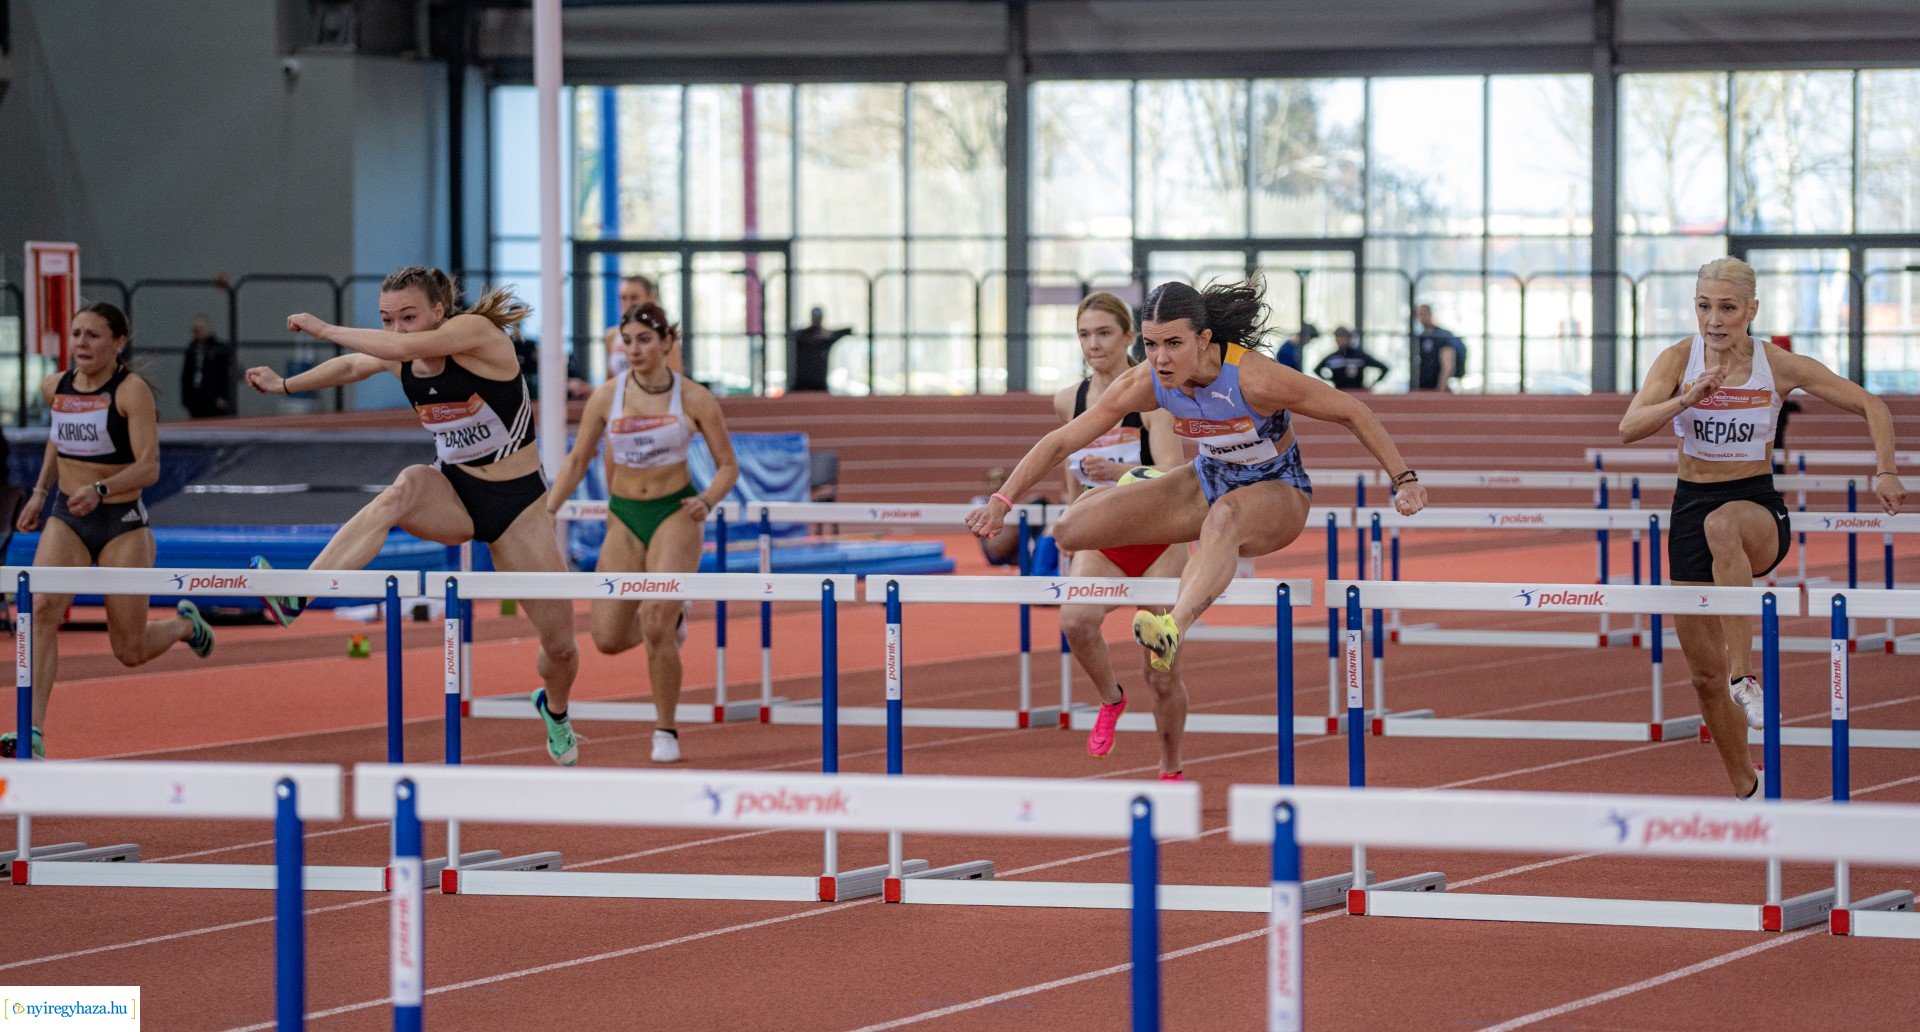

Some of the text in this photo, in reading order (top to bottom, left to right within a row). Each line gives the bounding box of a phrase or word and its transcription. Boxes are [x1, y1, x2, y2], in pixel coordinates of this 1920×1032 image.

[58, 422, 99, 442] KIRICSI
[1693, 416, 1755, 445] RÉPÁSI
[1500, 513, 1545, 525] polanik
[1835, 517, 1882, 530] polanik
[189, 575, 248, 591] polanik
[620, 578, 681, 595] polanik
[1067, 582, 1130, 600] polanik
[1537, 590, 1605, 608] polanik
[18, 631, 28, 668] polanik
[447, 637, 457, 675] polanik
[888, 642, 898, 680] polanik
[1348, 649, 1359, 688] polanik
[1833, 659, 1844, 699] polanik
[733, 786, 852, 821] polanik
[1641, 811, 1771, 848] polanik
